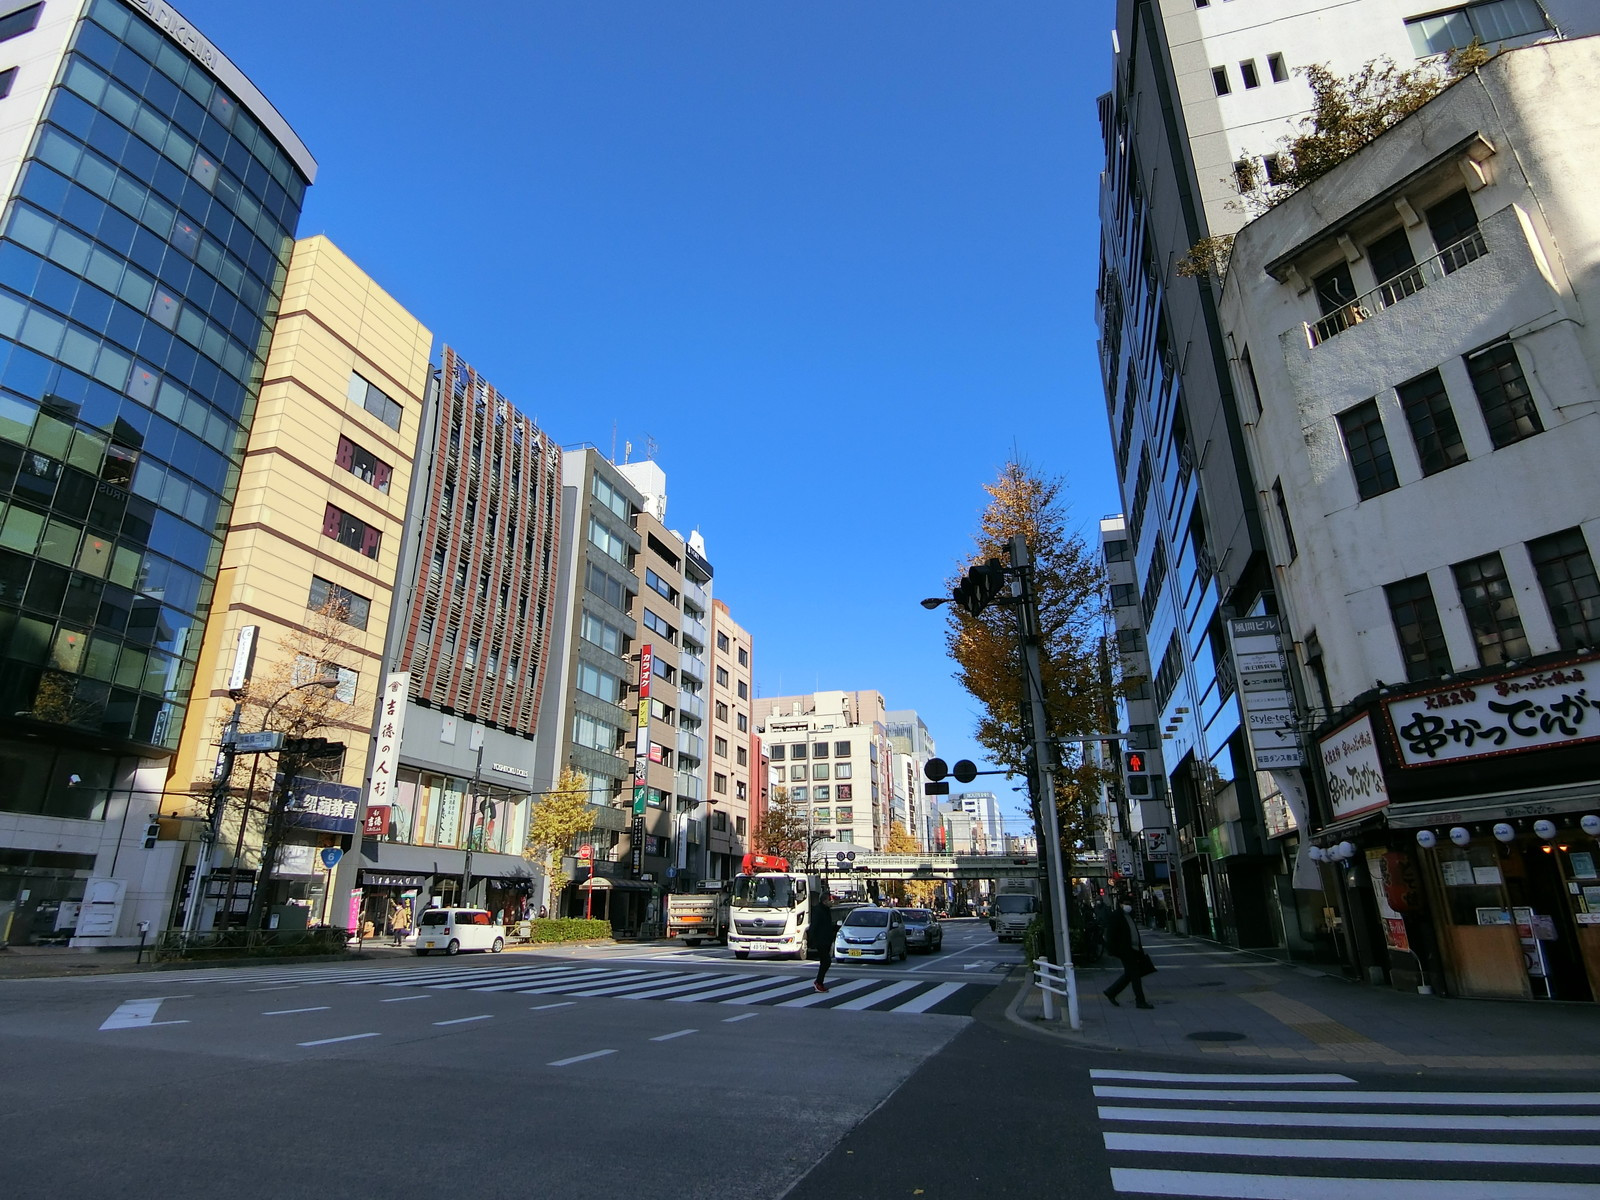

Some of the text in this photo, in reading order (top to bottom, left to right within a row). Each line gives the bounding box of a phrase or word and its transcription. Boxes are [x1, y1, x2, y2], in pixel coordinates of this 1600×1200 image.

[1234, 620, 1276, 631] 風間ビル
[641, 654, 651, 688] カラオケ
[1424, 687, 1476, 710] 大阪名物
[1250, 713, 1291, 726] Style-tec
[1400, 688, 1600, 758] 串かつでんが
[373, 698, 396, 797] 吉徳の人形
[1329, 761, 1383, 808] 串かつでんがな
[328, 852, 335, 861] 6
